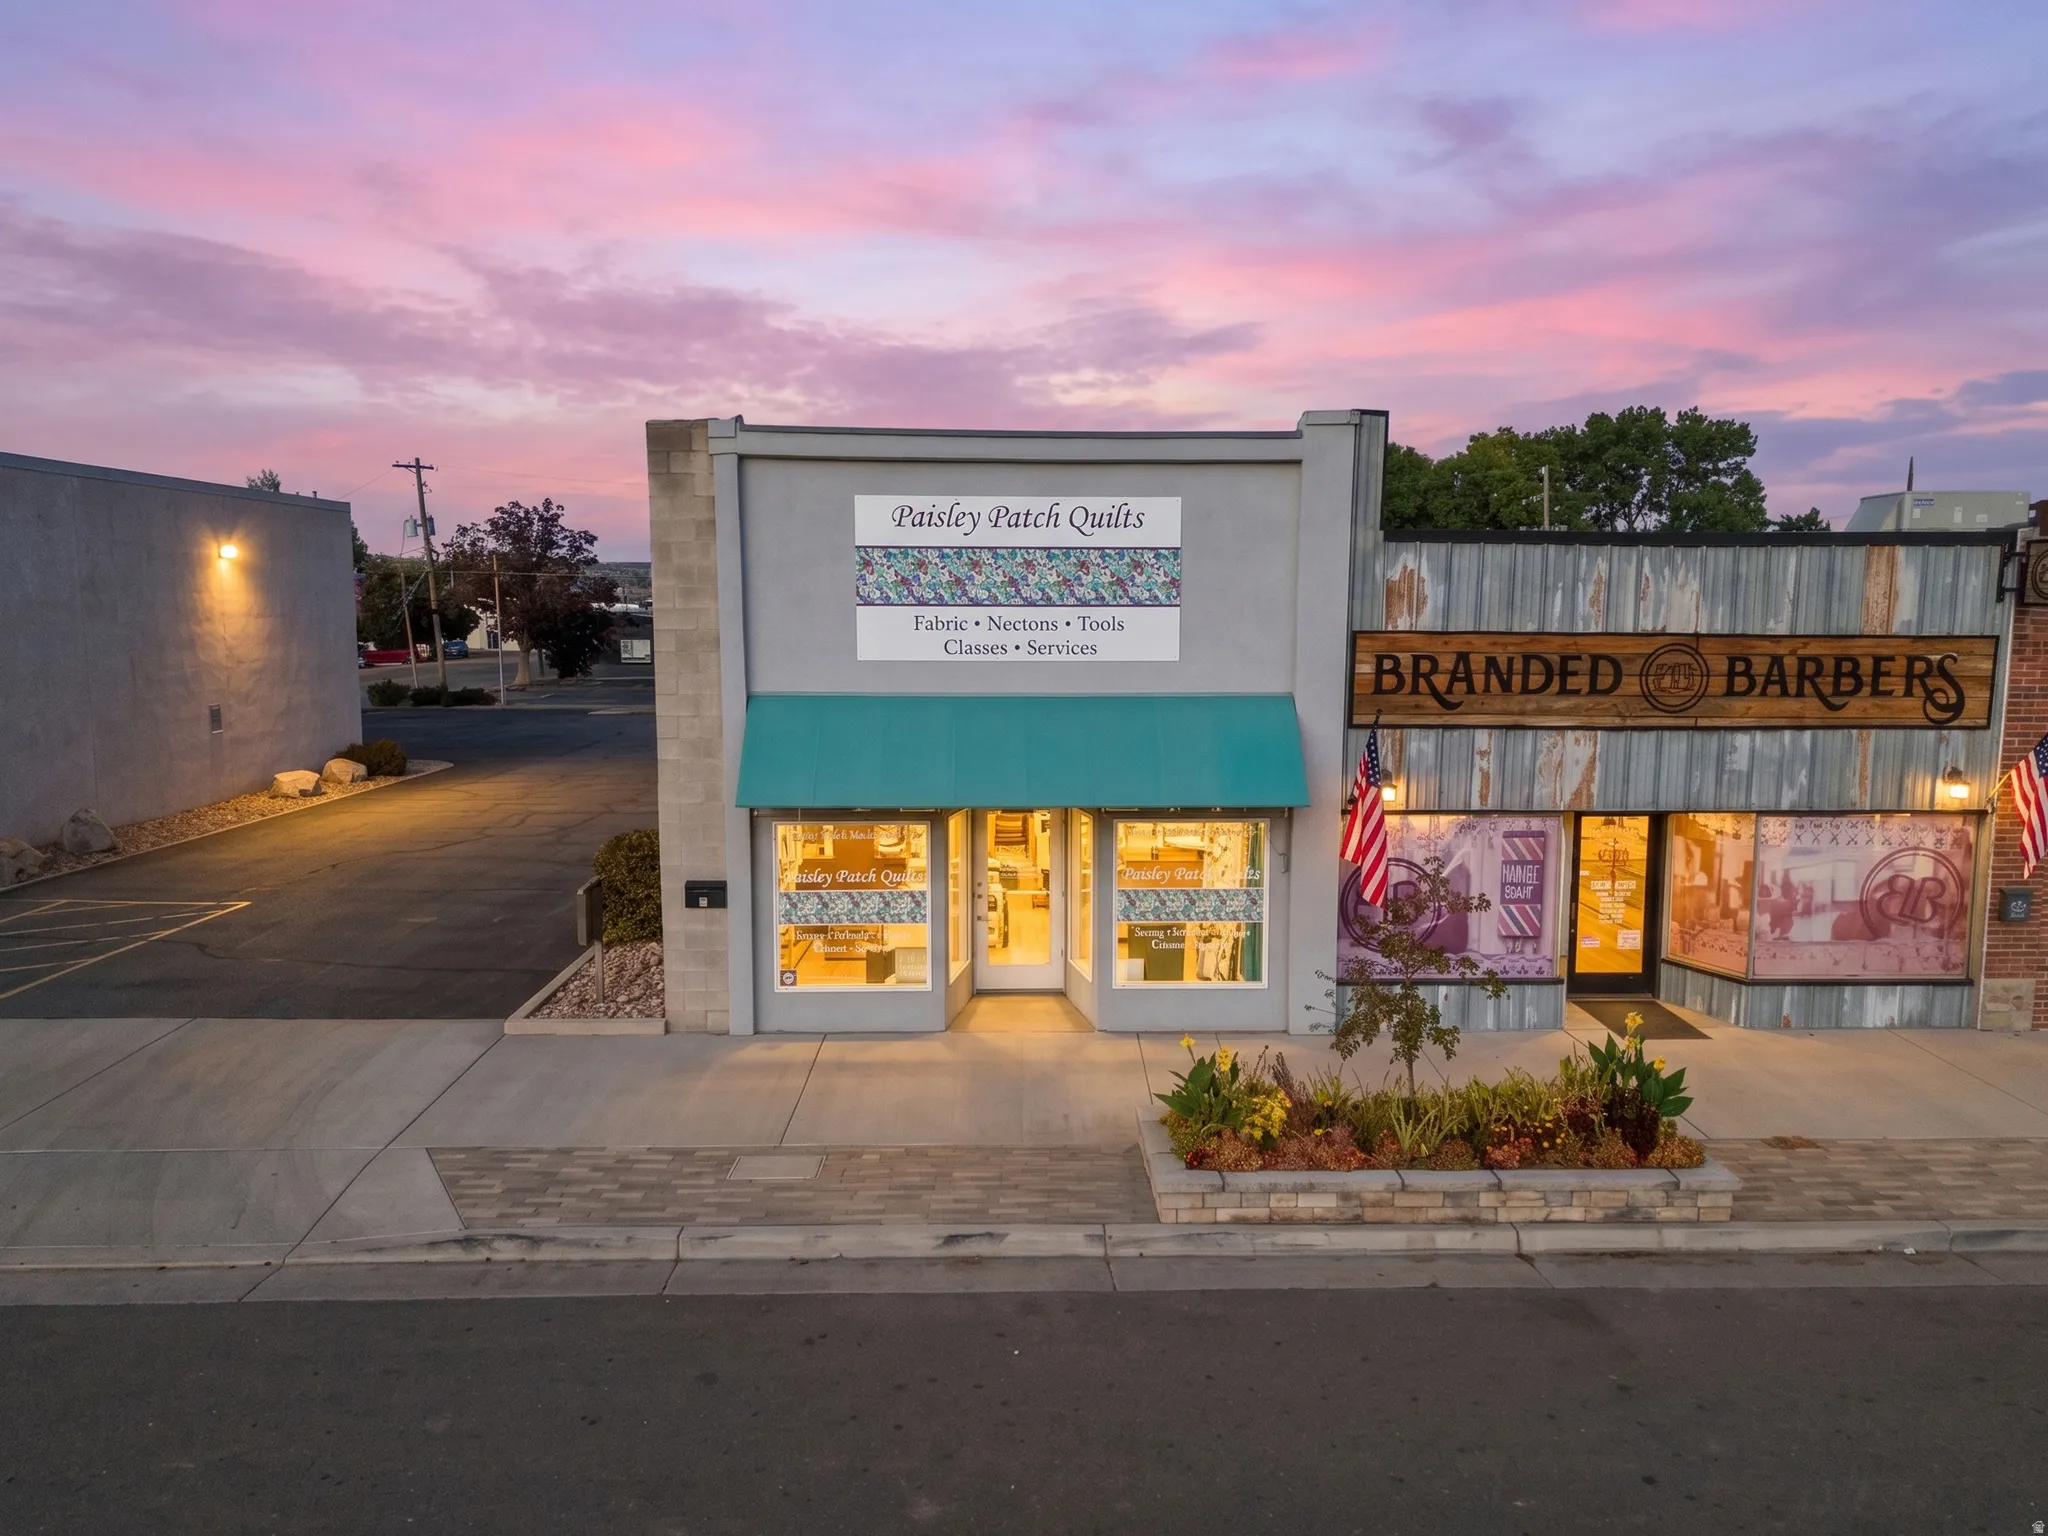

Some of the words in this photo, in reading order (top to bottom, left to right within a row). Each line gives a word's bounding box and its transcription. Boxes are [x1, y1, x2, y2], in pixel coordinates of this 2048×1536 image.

[892, 502, 981, 537] Paisley
[987, 502, 1061, 529] Patch
[1069, 502, 1146, 537] Quilts
[913, 615, 968, 632] Fabric
[987, 615, 1059, 632] Nectons
[1078, 615, 1125, 632] Tools
[944, 638, 1008, 656] Classes
[1027, 639, 1098, 656] Services
[1371, 652, 1623, 711] BRANDED
[1722, 653, 1966, 725] BARBERS
[836, 868, 877, 884] Patch
[1122, 865, 1170, 884] Paisley
